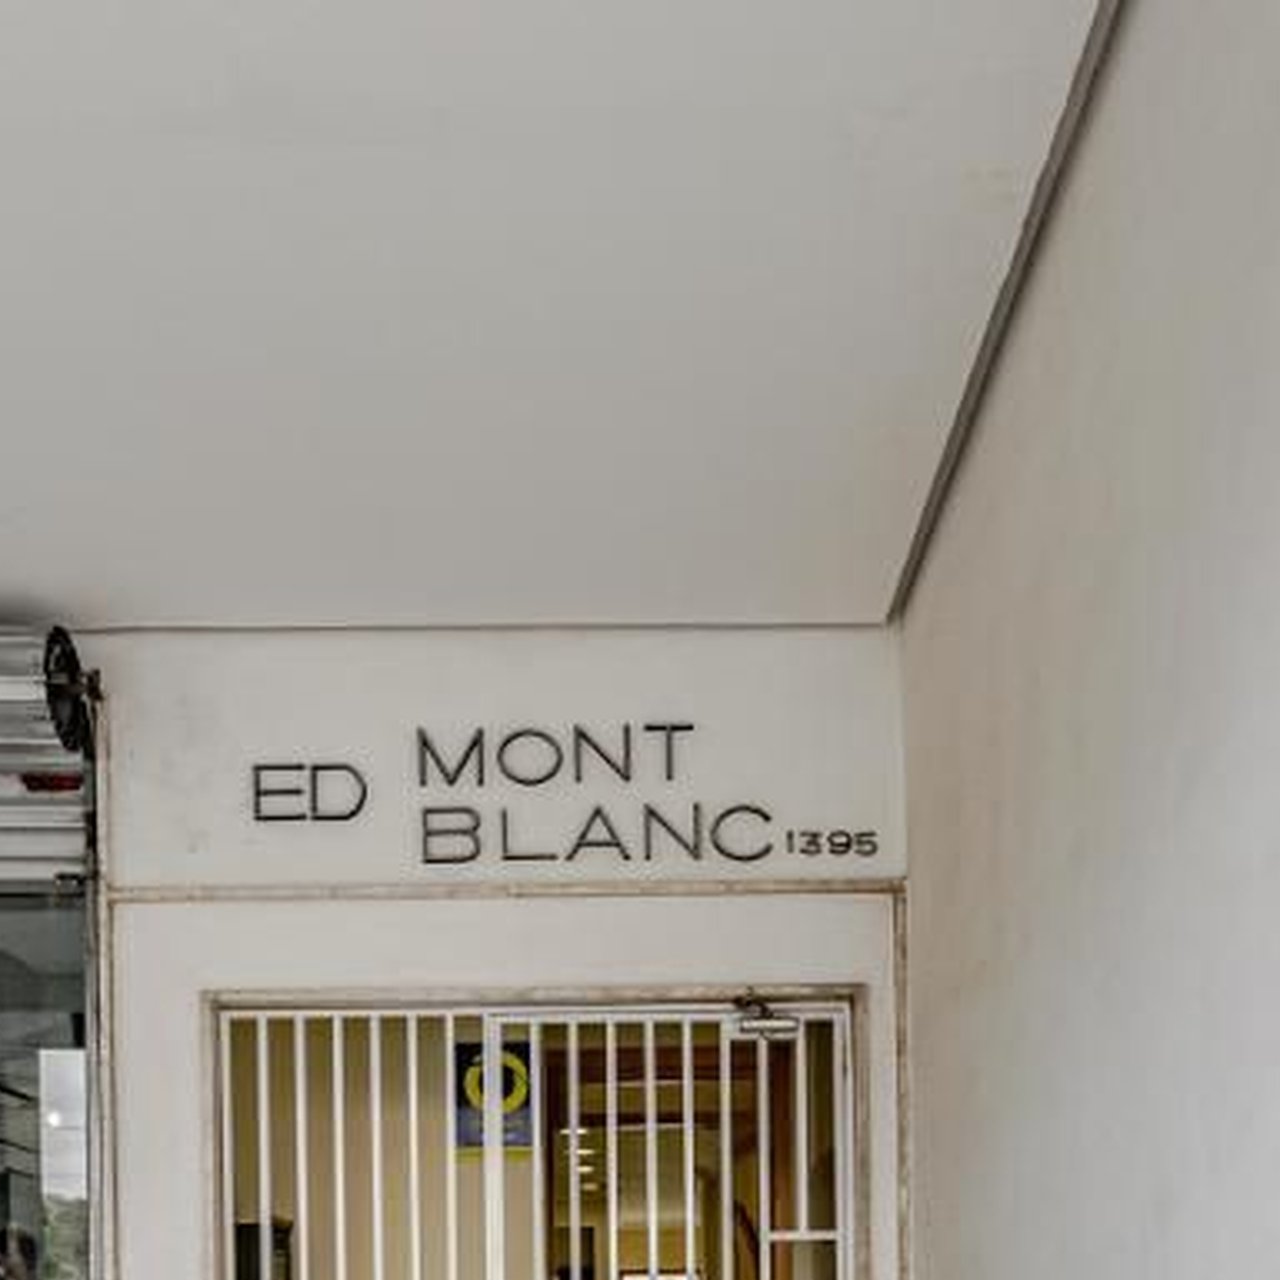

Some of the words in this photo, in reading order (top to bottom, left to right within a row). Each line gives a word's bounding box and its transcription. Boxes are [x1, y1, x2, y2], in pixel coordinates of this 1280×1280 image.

[417, 723, 694, 787] MONT
[252, 763, 367, 822] ED
[422, 803, 773, 864] BLANC
[786, 830, 878, 857] 1395
